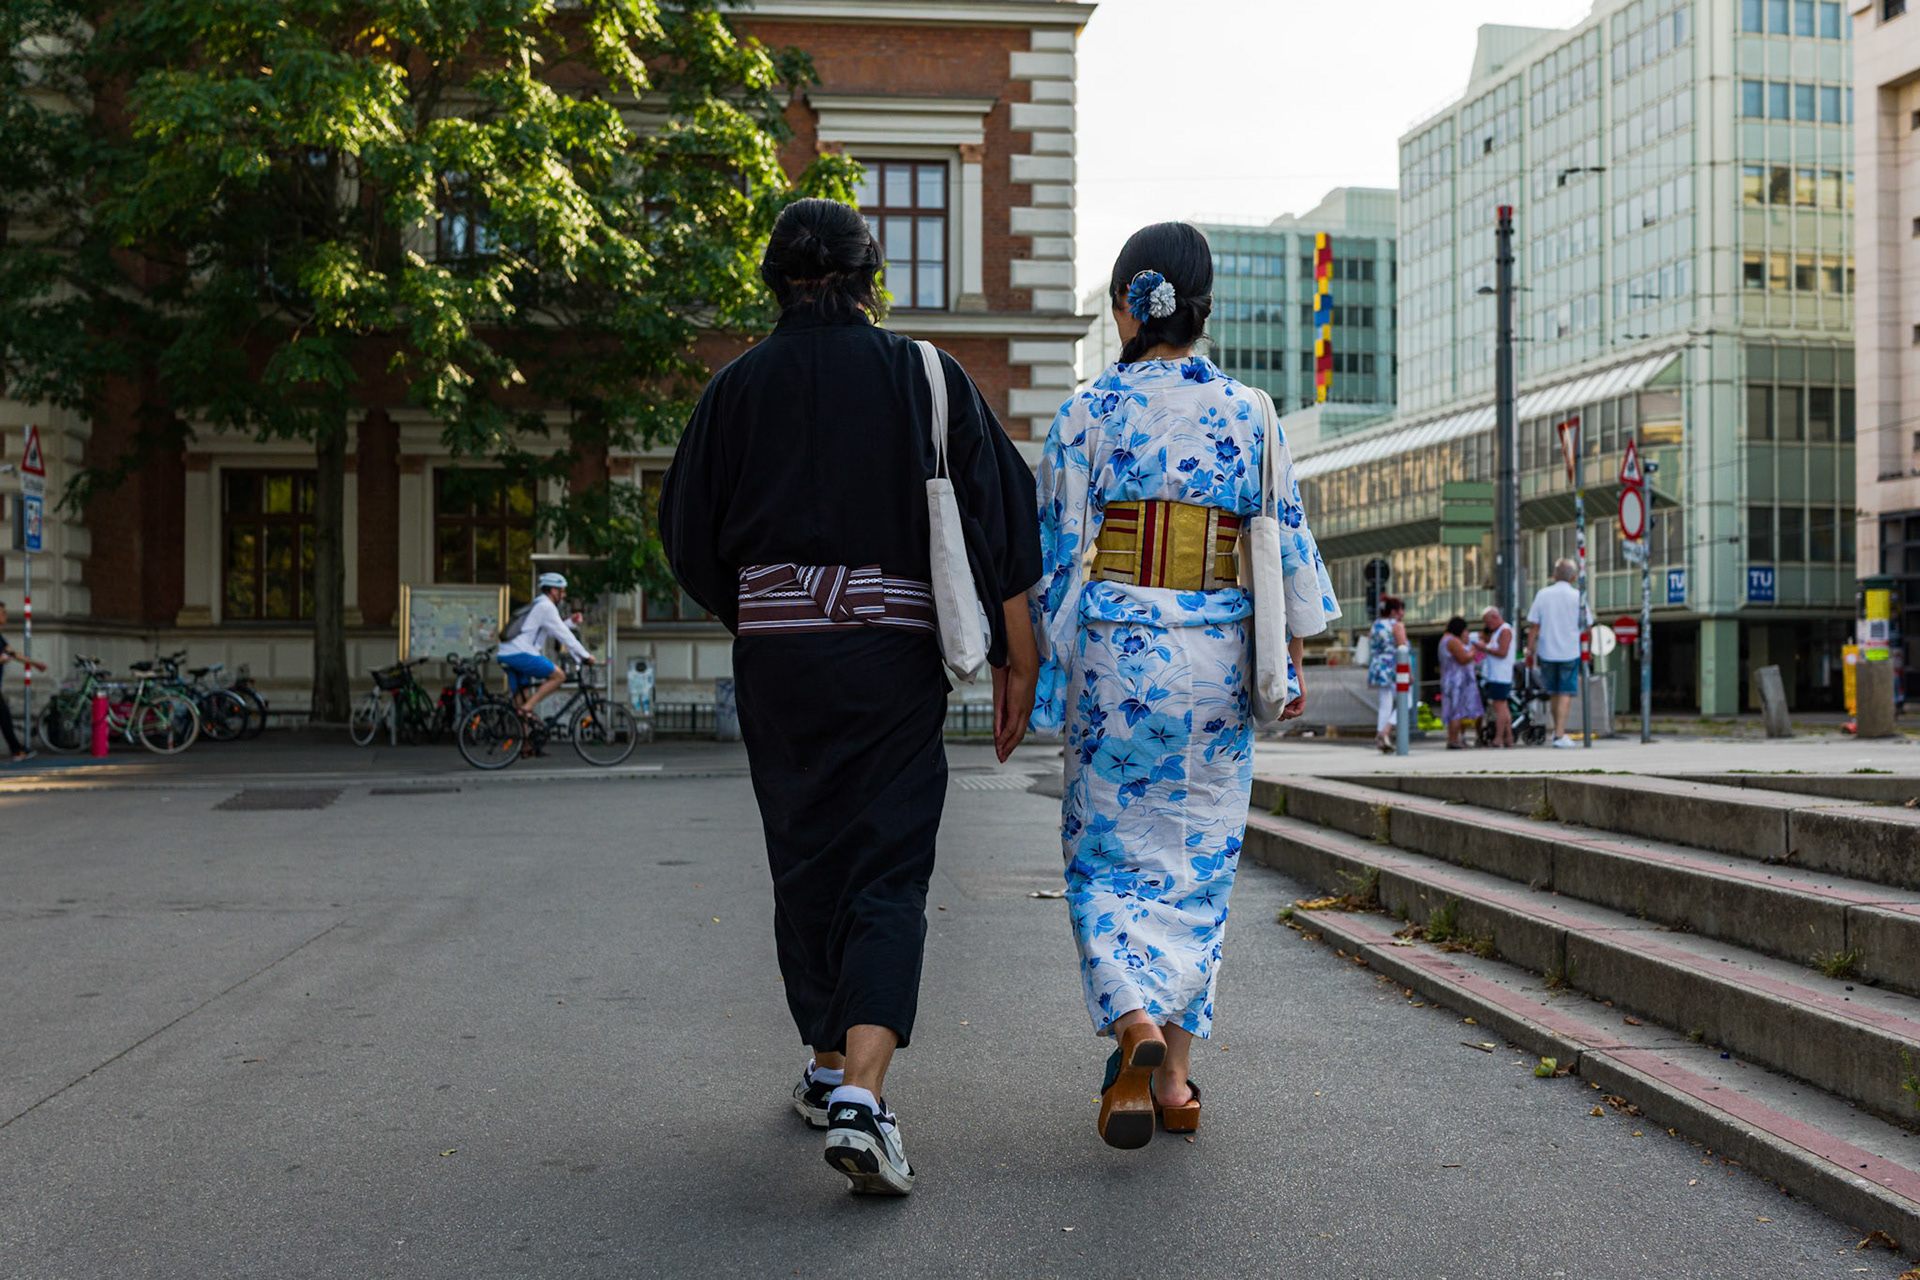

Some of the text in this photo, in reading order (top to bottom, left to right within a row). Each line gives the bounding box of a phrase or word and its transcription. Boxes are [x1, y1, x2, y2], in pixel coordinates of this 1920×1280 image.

[1669, 572, 1685, 590] TU
[1749, 570, 1772, 587] TU
[834, 1108, 858, 1121] NB
